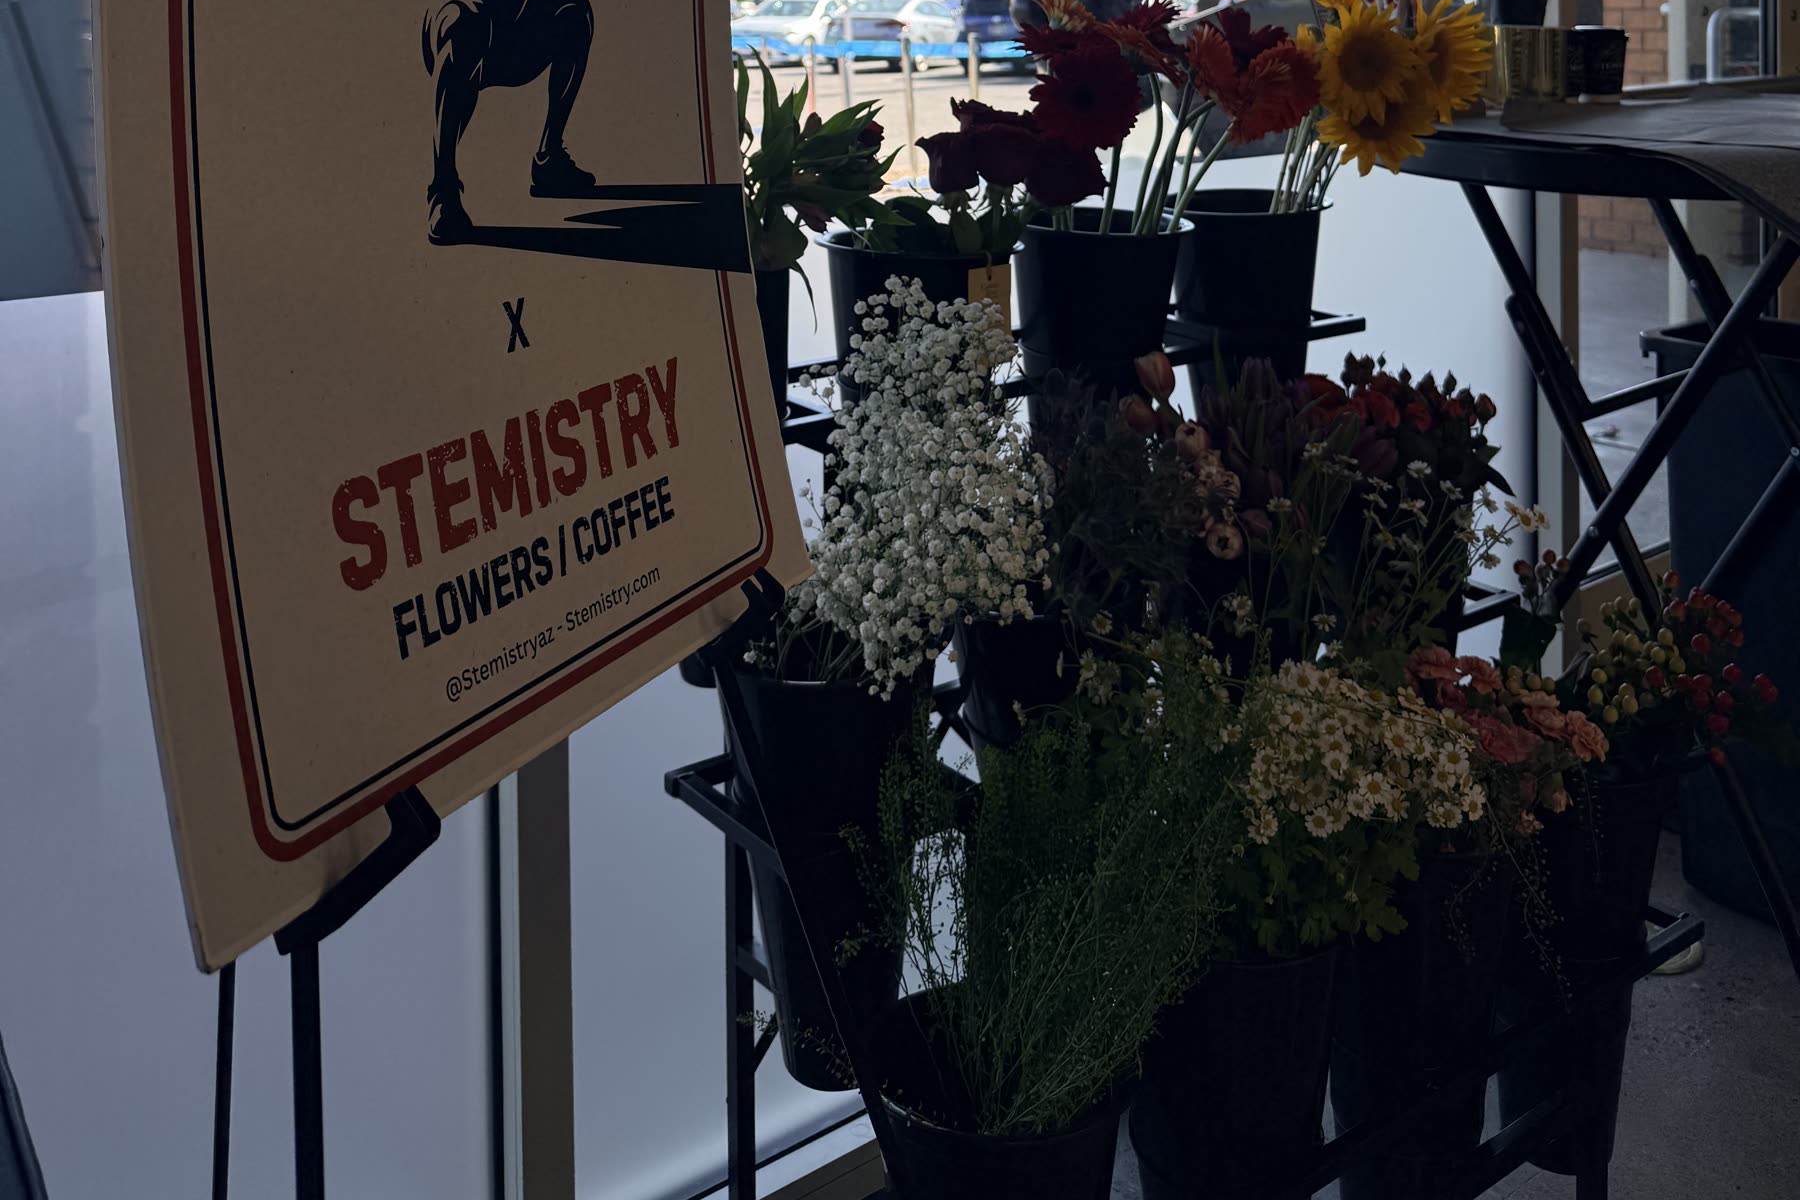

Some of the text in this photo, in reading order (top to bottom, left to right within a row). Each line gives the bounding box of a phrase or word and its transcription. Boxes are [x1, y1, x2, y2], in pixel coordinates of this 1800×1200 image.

[502, 297, 531, 354] X
[331, 356, 680, 592] STEMISTRY
[392, 476, 676, 661] FLOWERS / COFFEE
[445, 625, 556, 702] @Stemistryaz
[564, 567, 662, 632] Stemistry.com
